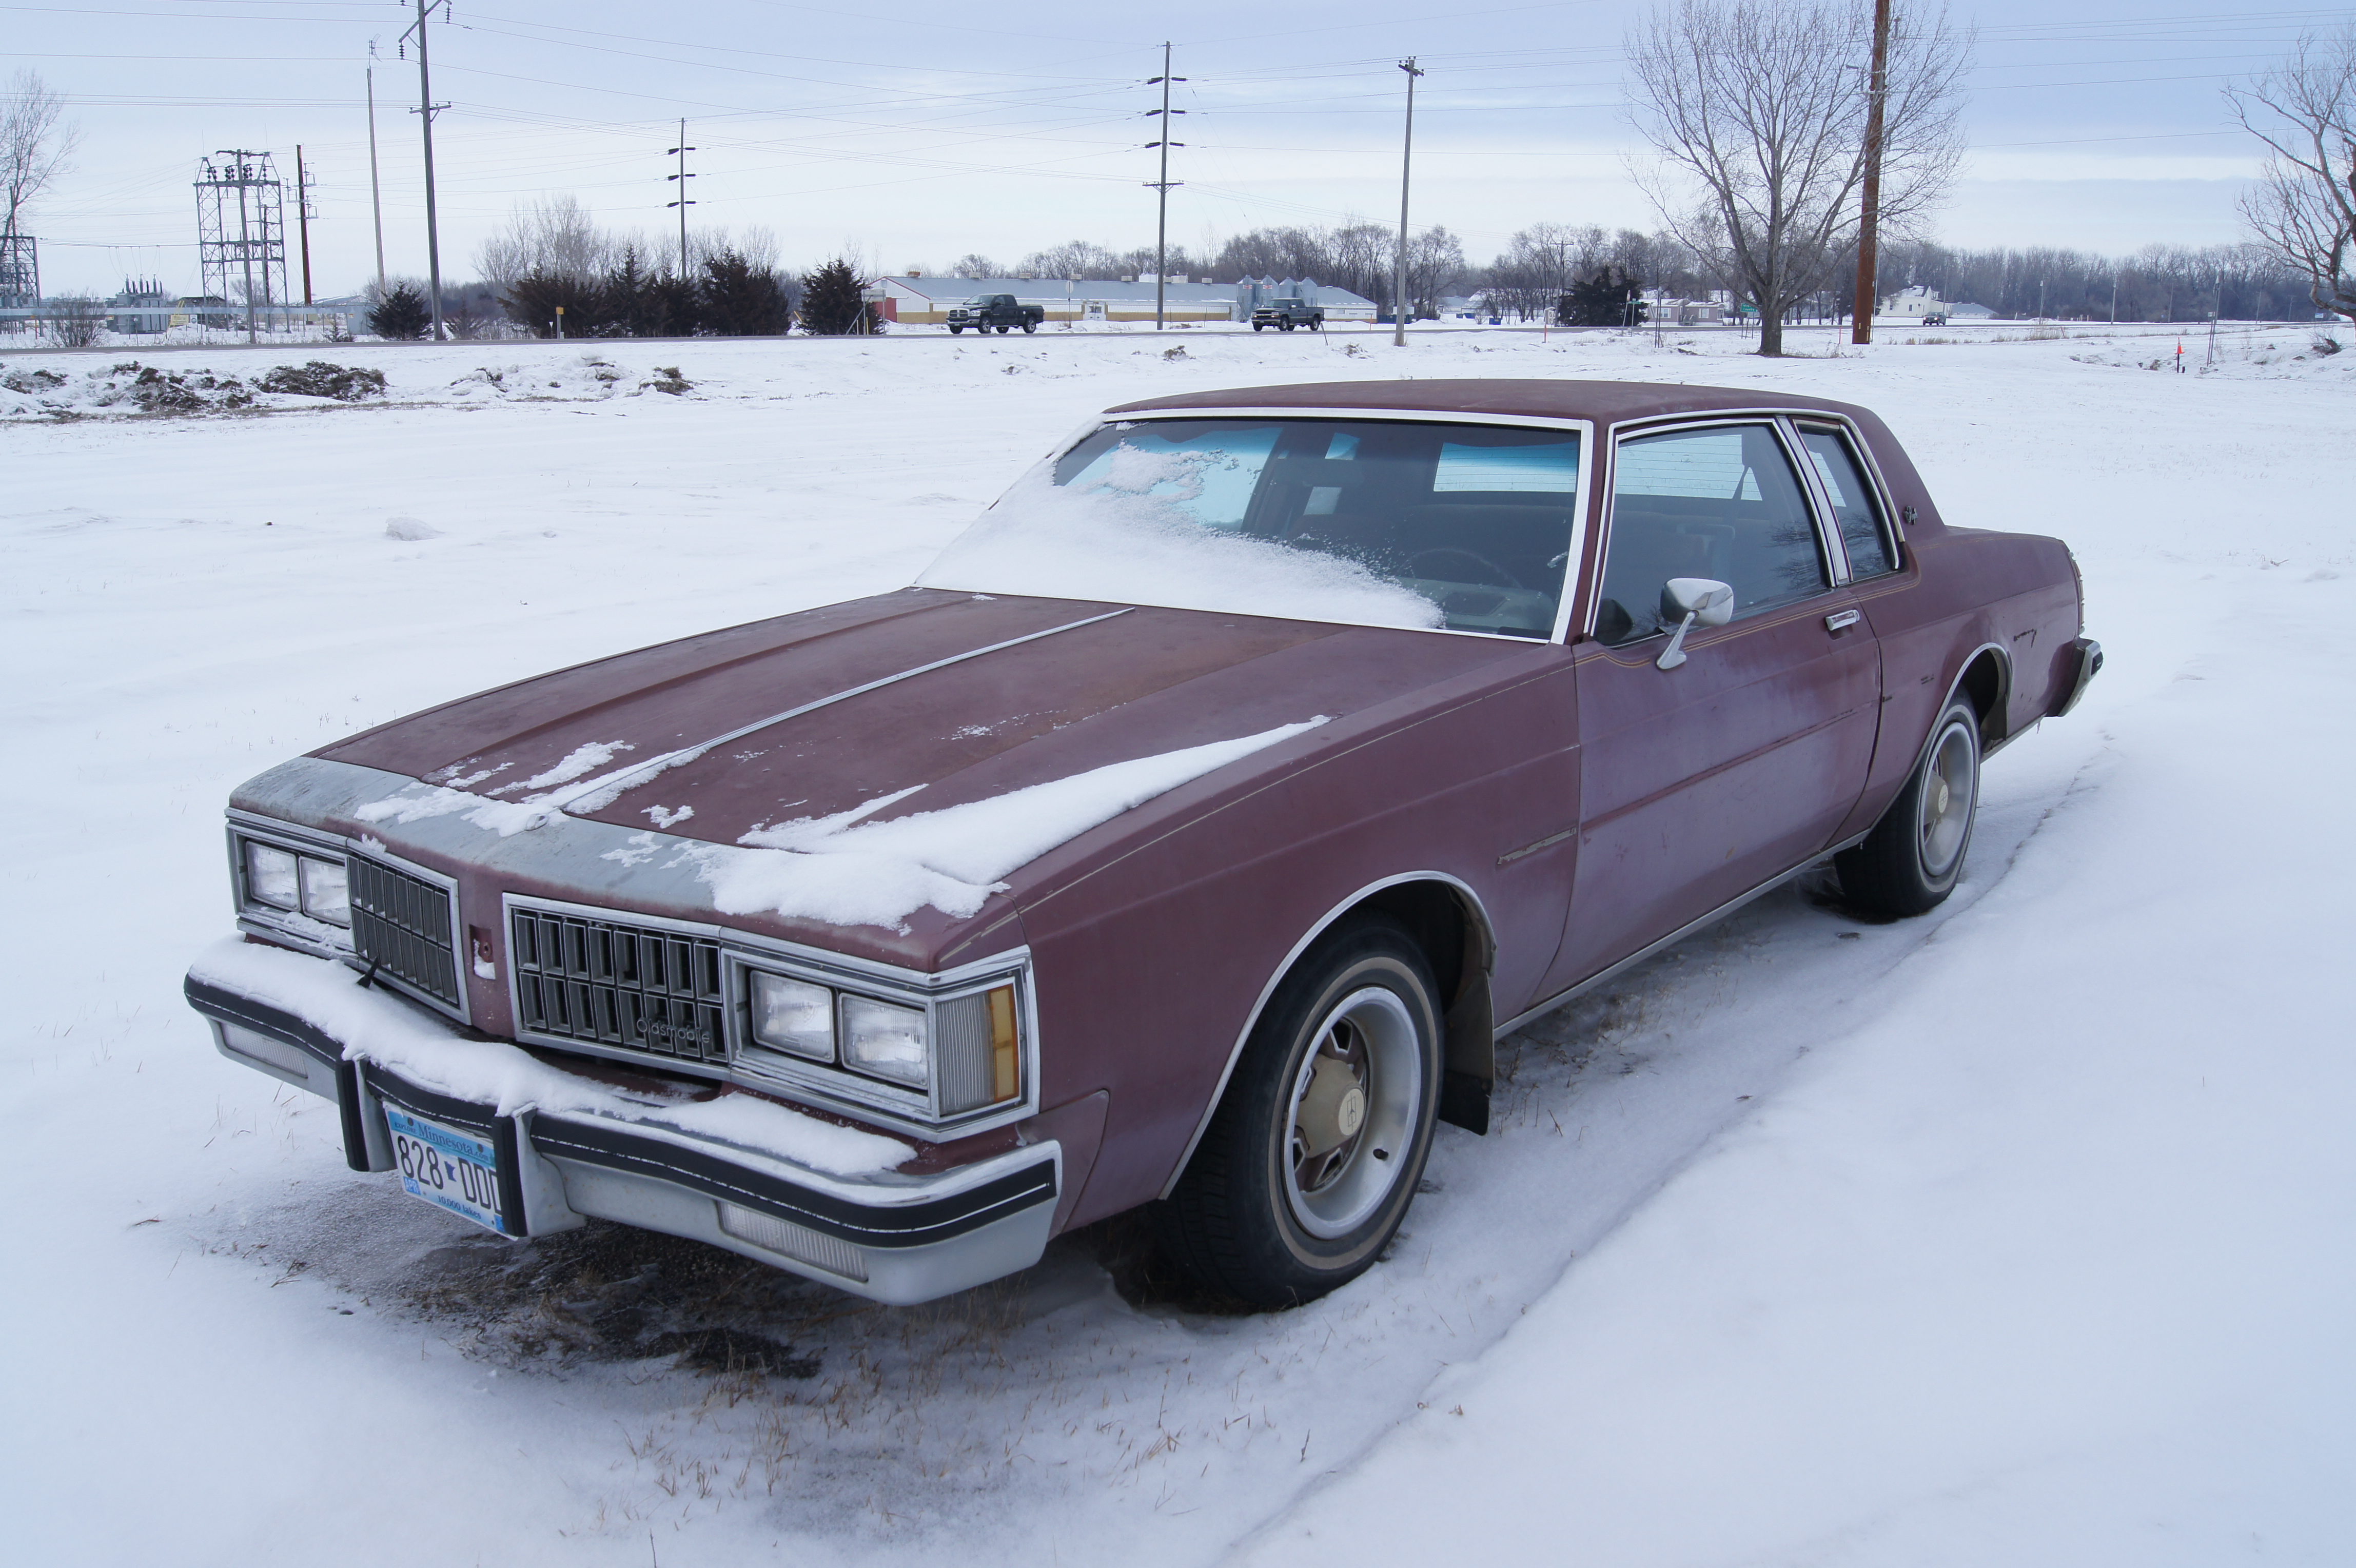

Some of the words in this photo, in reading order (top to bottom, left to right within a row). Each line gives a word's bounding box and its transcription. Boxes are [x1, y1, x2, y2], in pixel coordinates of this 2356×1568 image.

[637, 1017, 711, 1043] Oldsmobile
[395, 1122, 417, 1134] EXPLORE
[397, 1135, 444, 1190] 828
[405, 1177, 419, 1194] APR
[438, 1195, 461, 1210] 10,000
[462, 1205, 482, 1220] lakes
